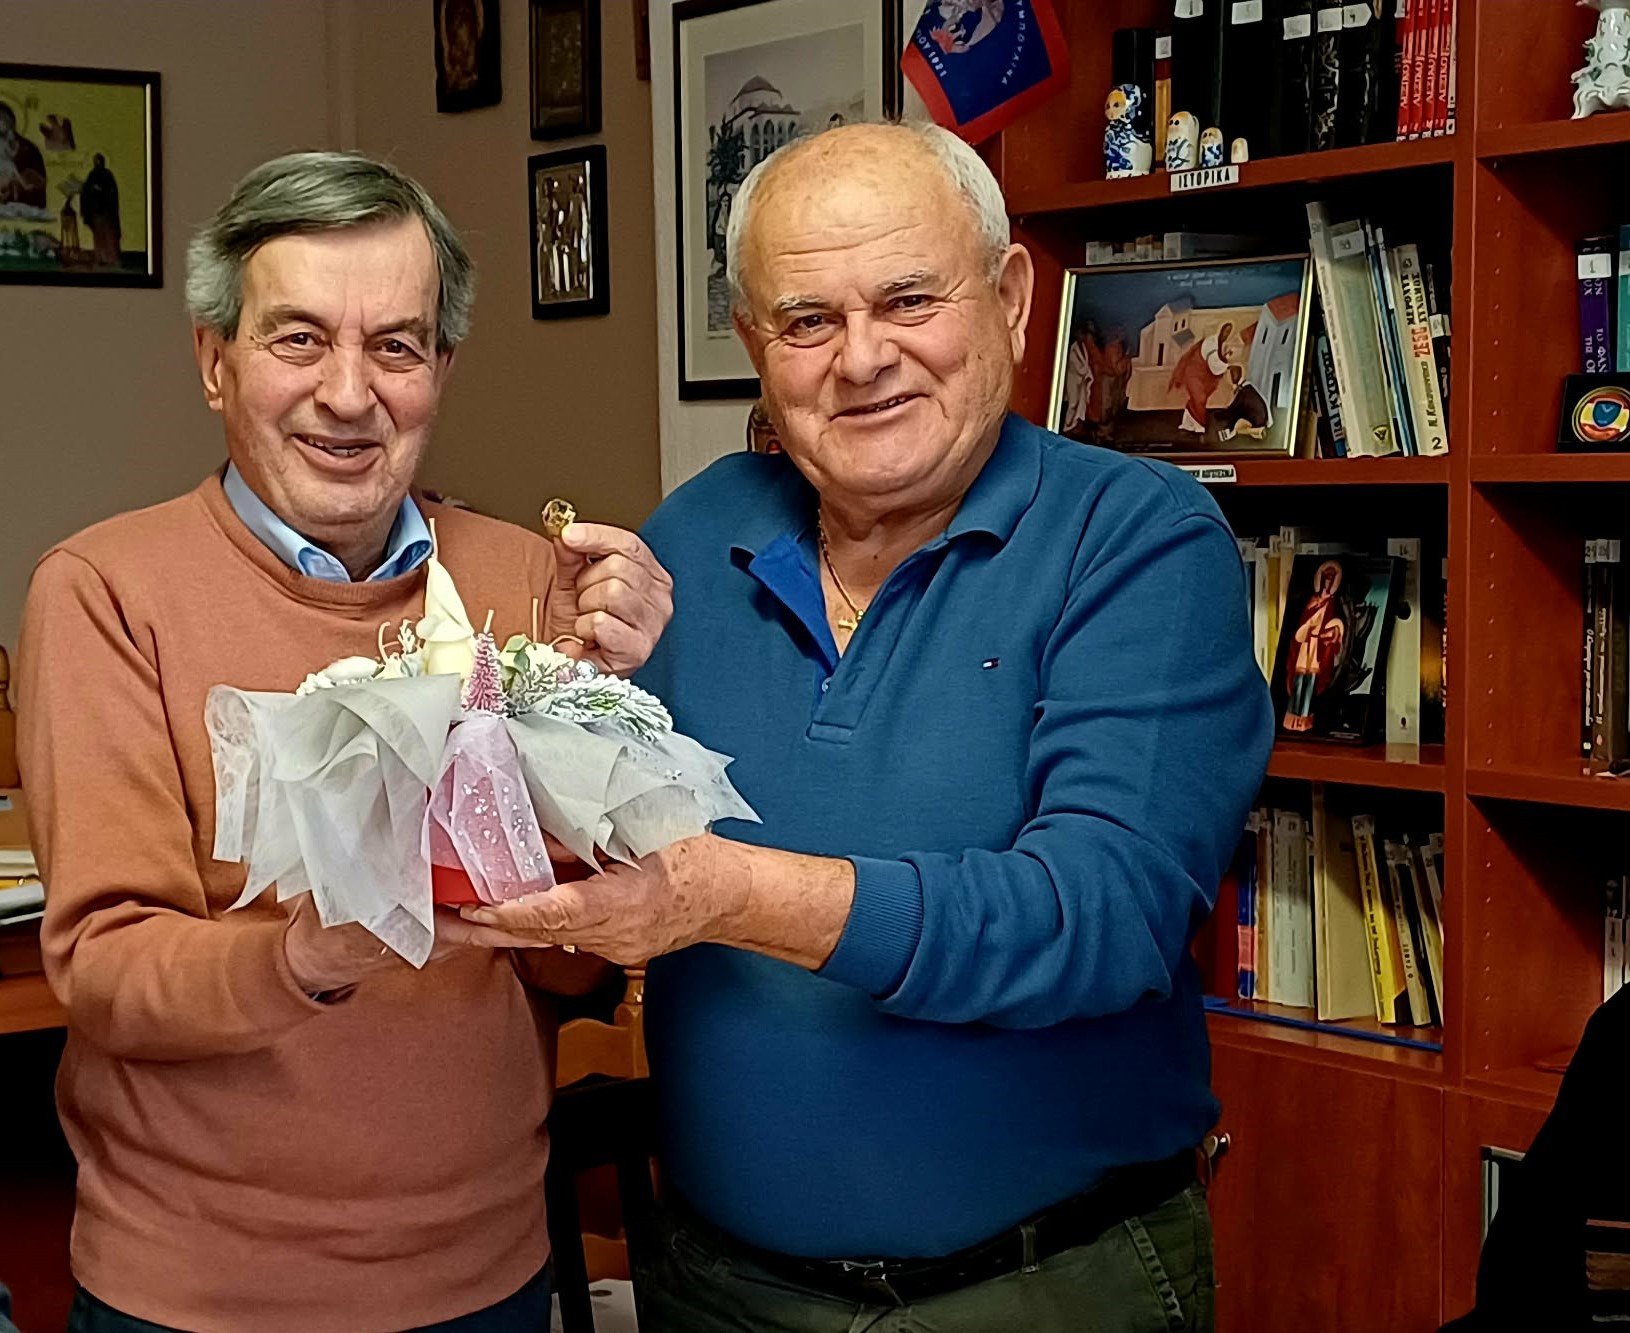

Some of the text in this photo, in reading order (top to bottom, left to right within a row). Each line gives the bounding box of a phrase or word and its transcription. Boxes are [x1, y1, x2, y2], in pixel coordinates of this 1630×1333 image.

[928, 51, 948, 78] 1821
[1178, 167, 1231, 189] ΙΣΤΟΡΙΚΑ
[1432, 437, 1443, 450] 2
